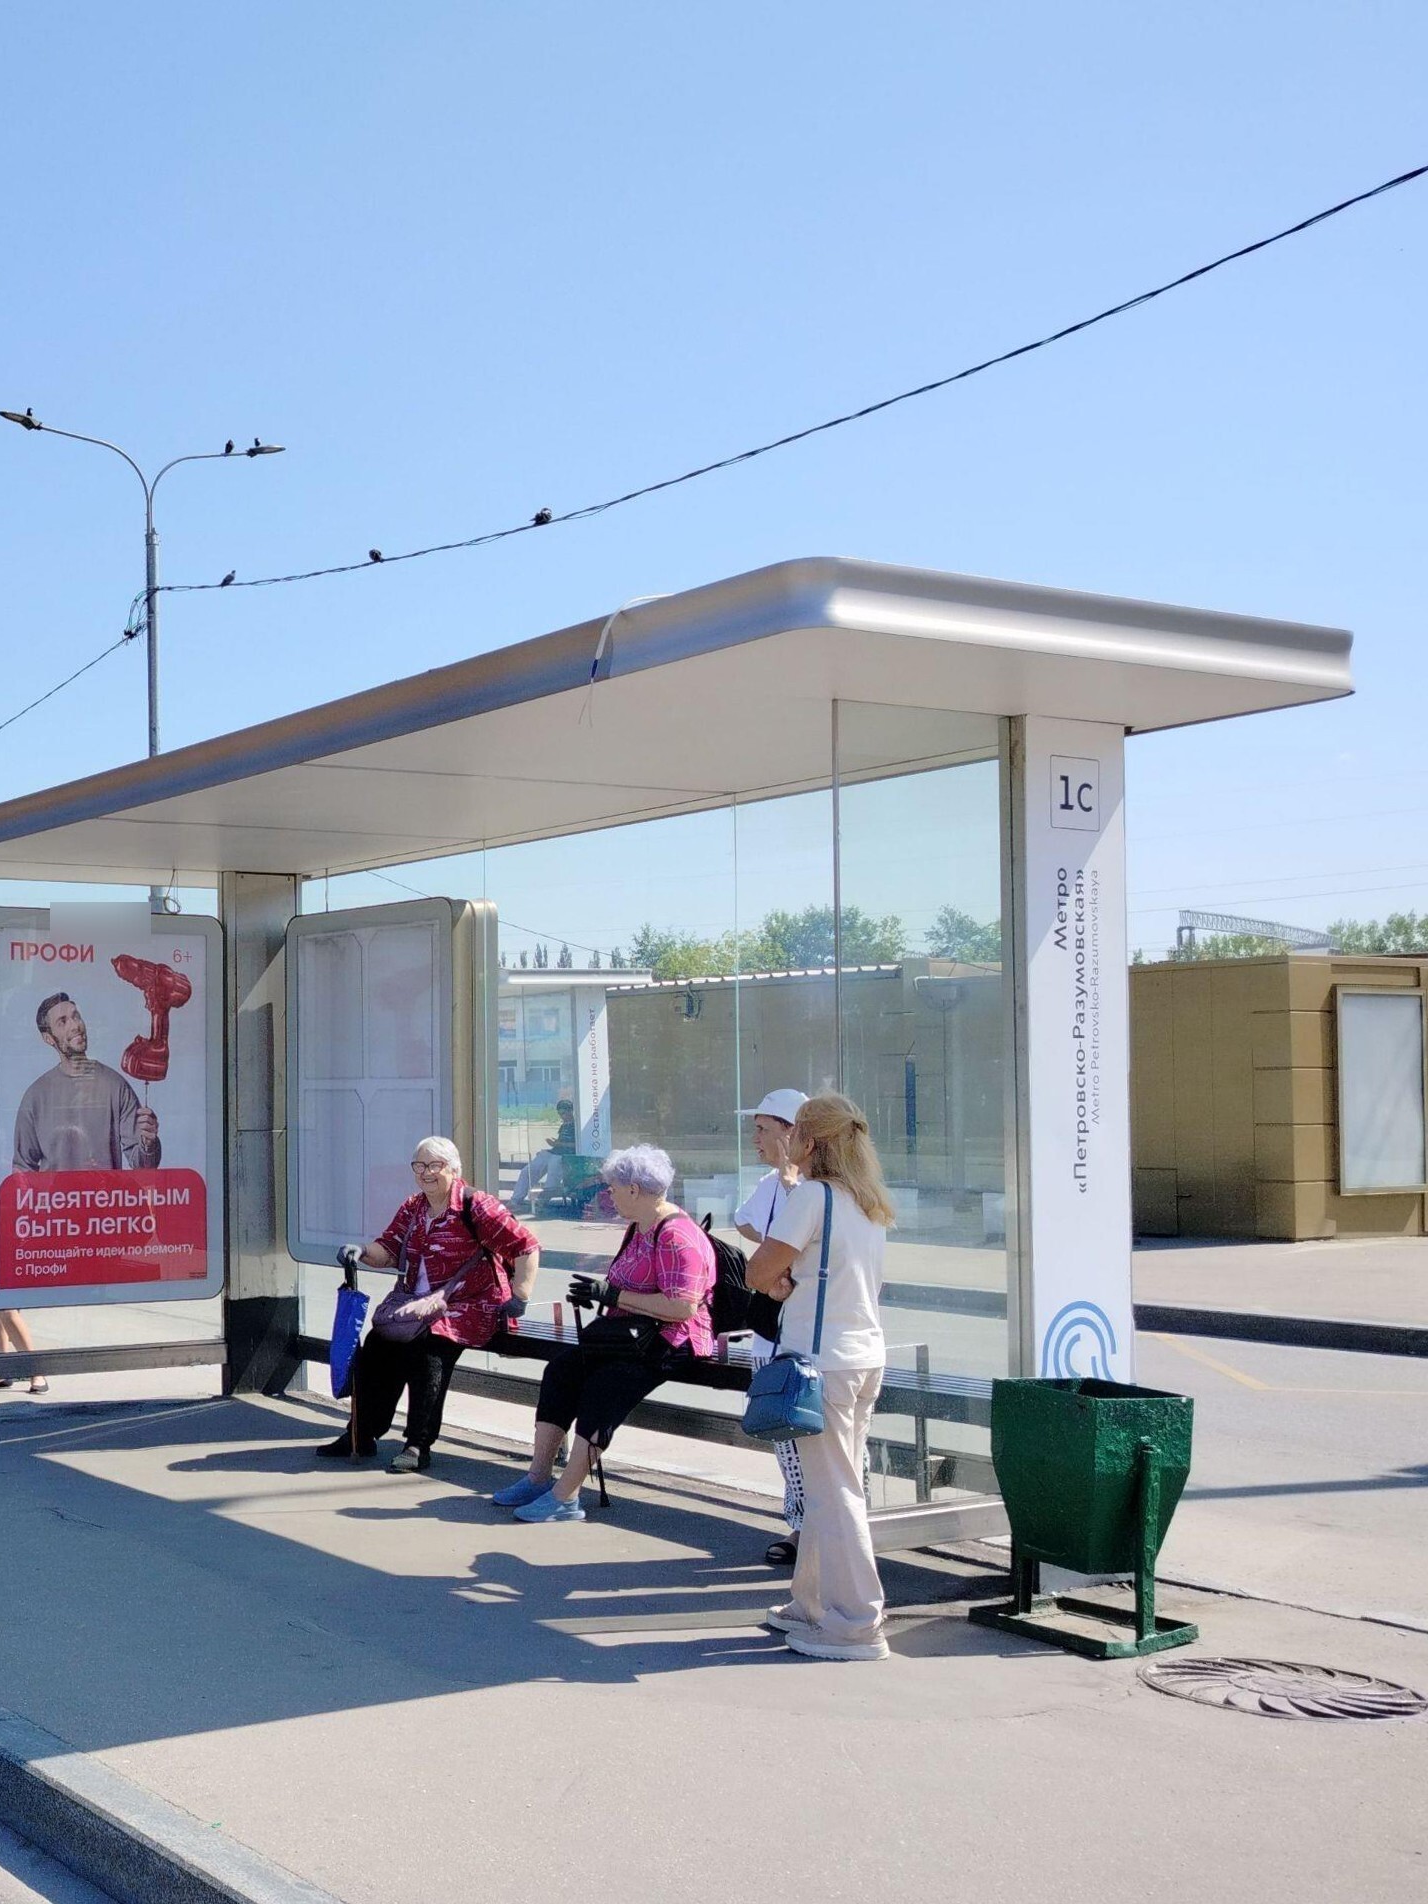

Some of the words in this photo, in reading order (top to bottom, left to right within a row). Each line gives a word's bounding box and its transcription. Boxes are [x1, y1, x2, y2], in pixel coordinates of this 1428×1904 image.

[1054, 868, 1070, 950] Метро
[10, 941, 94, 963] ПРОФИ
[173, 949, 193, 963] 6+
[1090, 870, 1100, 1069] Petrovsko-Razumovskaya
[590, 1009, 598, 1060] работает
[1072, 869, 1089, 1194] «Петровско-Разумовская»
[591, 1063, 598, 1076] не
[592, 1079, 600, 1139] Остановка
[1091, 1075, 1100, 1125] Metro
[16, 1188, 190, 1213] Идеятельным
[15, 1215, 81, 1238] быть
[85, 1216, 156, 1235] легко
[15, 1247, 93, 1260] Воплощайте
[95, 1246, 125, 1258] идеи
[128, 1246, 142, 1255] по
[144, 1243, 194, 1257] ремонту
[15, 1267, 23, 1276] с
[26, 1263, 67, 1277] Профи
